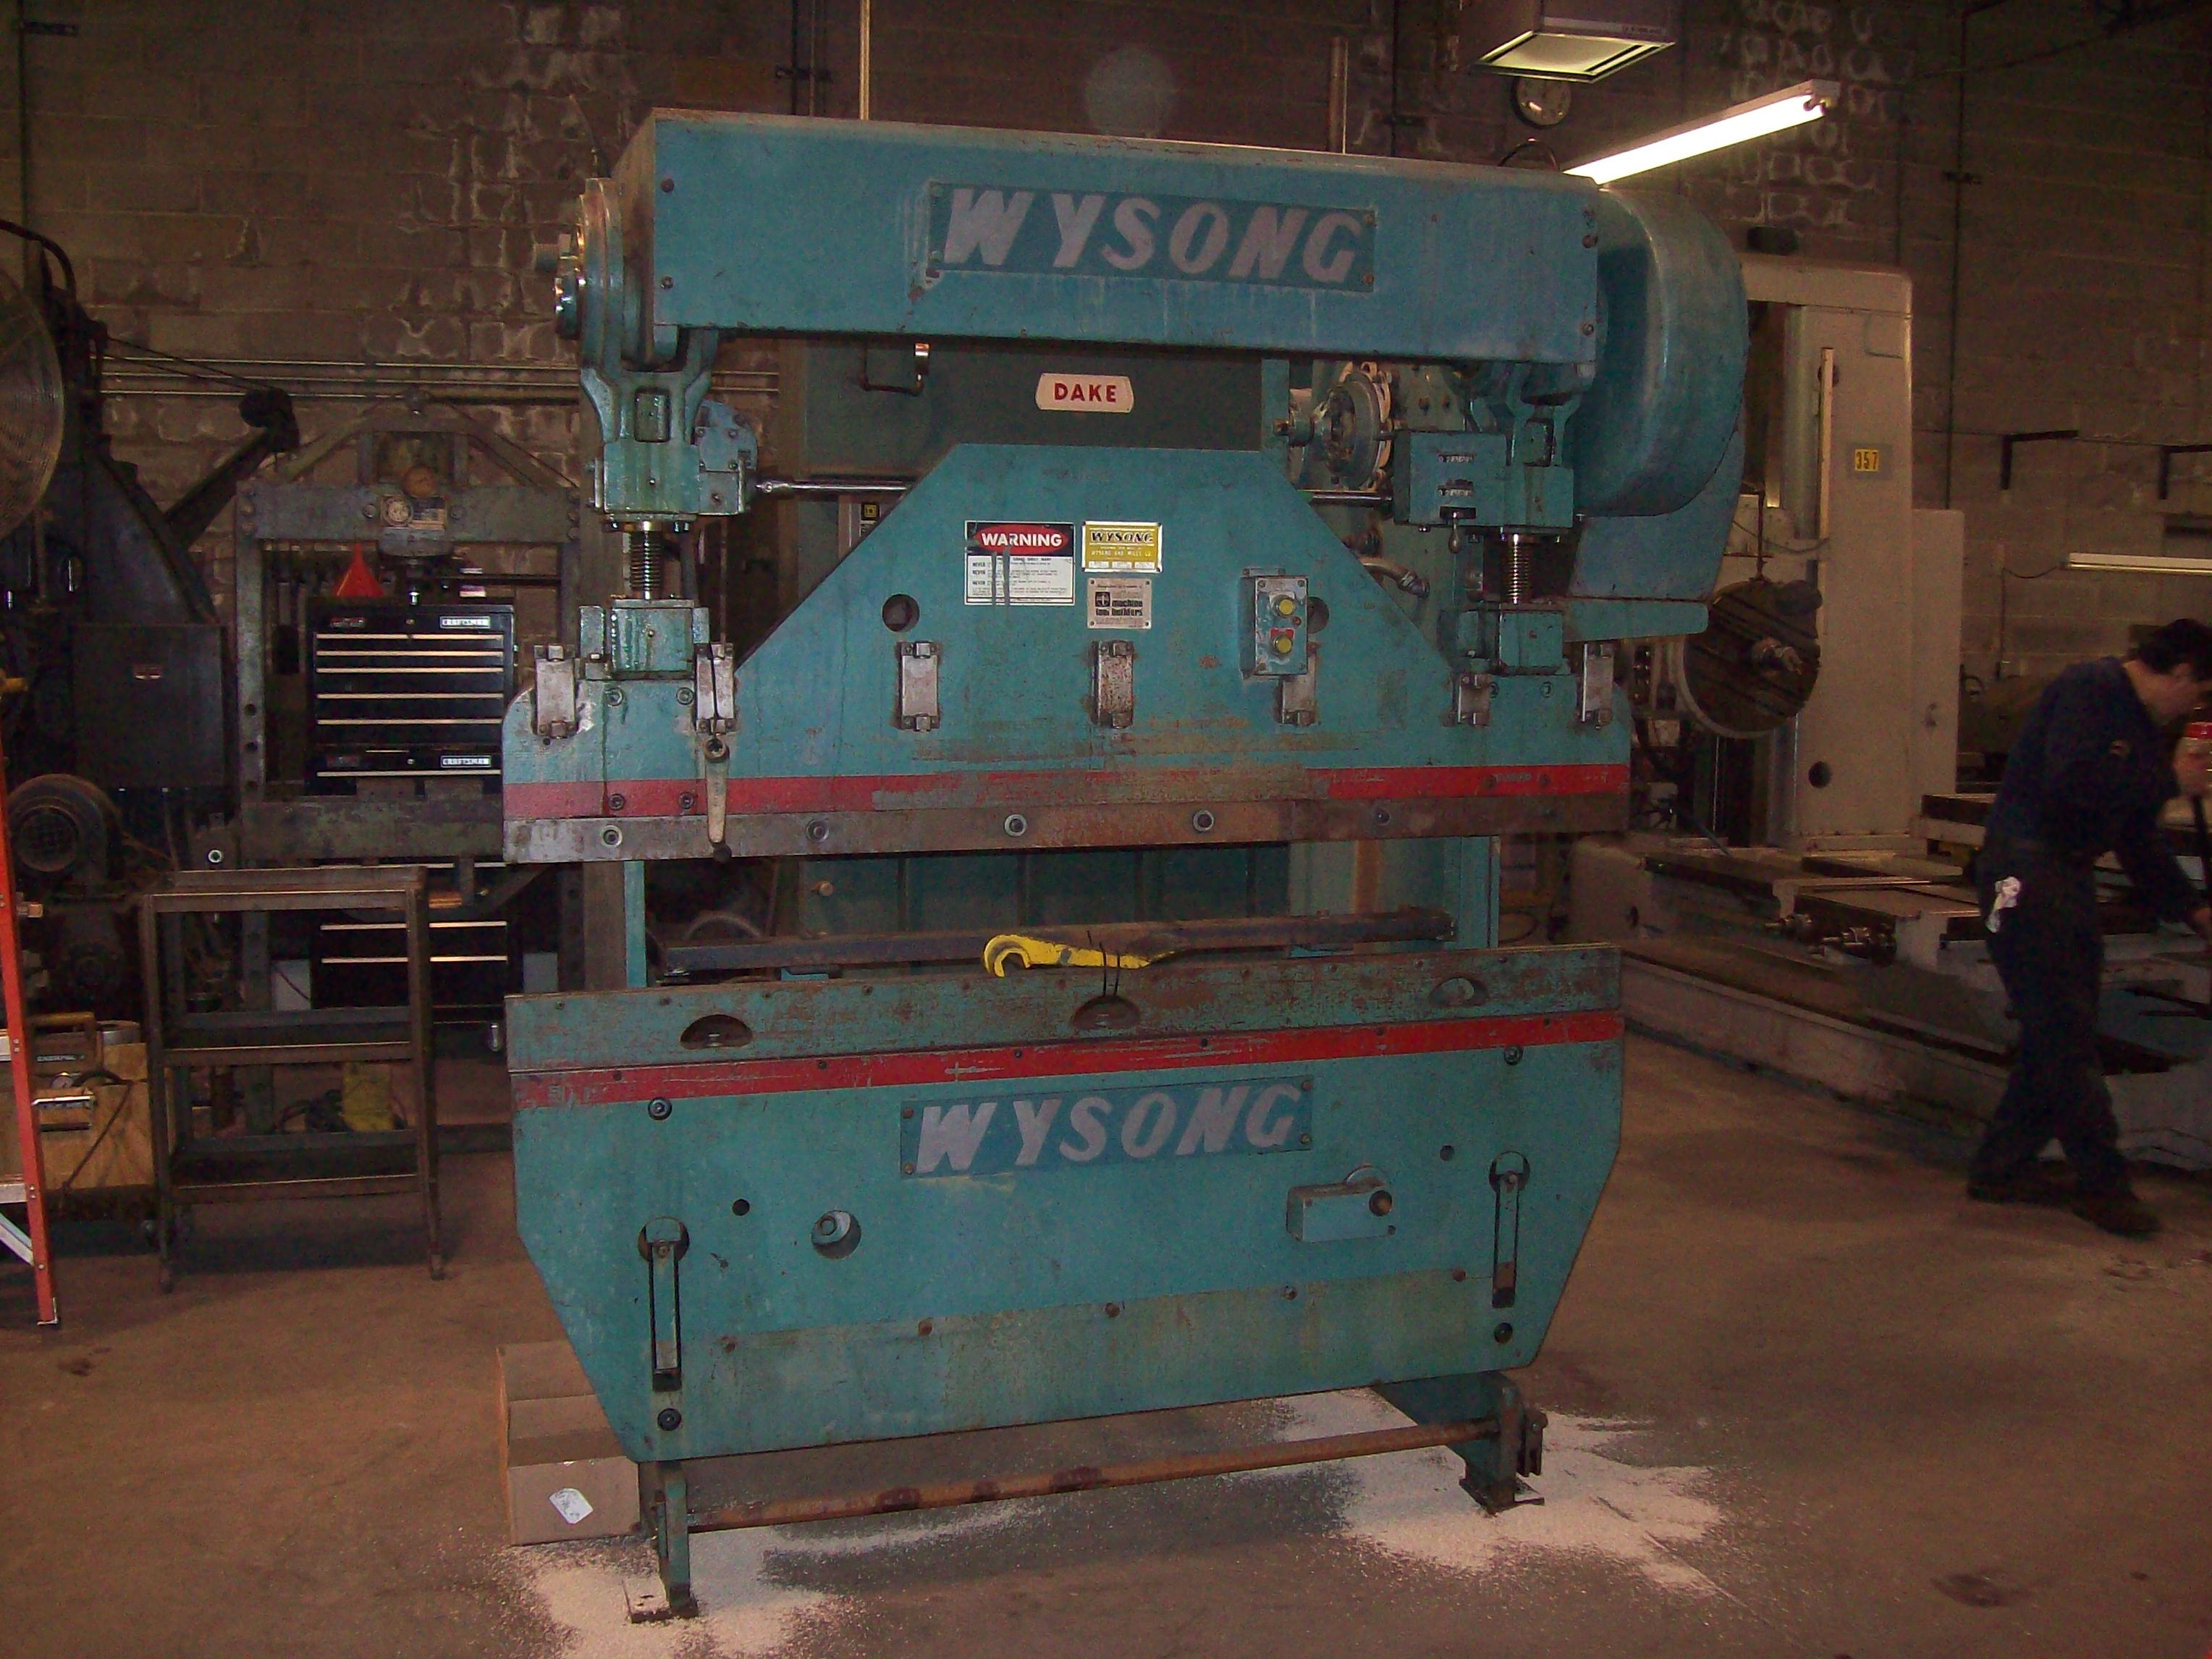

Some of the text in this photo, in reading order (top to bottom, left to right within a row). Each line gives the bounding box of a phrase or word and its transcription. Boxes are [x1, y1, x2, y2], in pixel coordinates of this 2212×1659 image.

[944, 189, 1362, 283] WYSONG
[1053, 382, 1117, 403] DAKE
[1856, 451, 1878, 470] 357
[981, 533, 1063, 547] WARNING
[1091, 531, 1153, 543] WYSONG
[916, 1086, 1301, 1173] WYSONG
